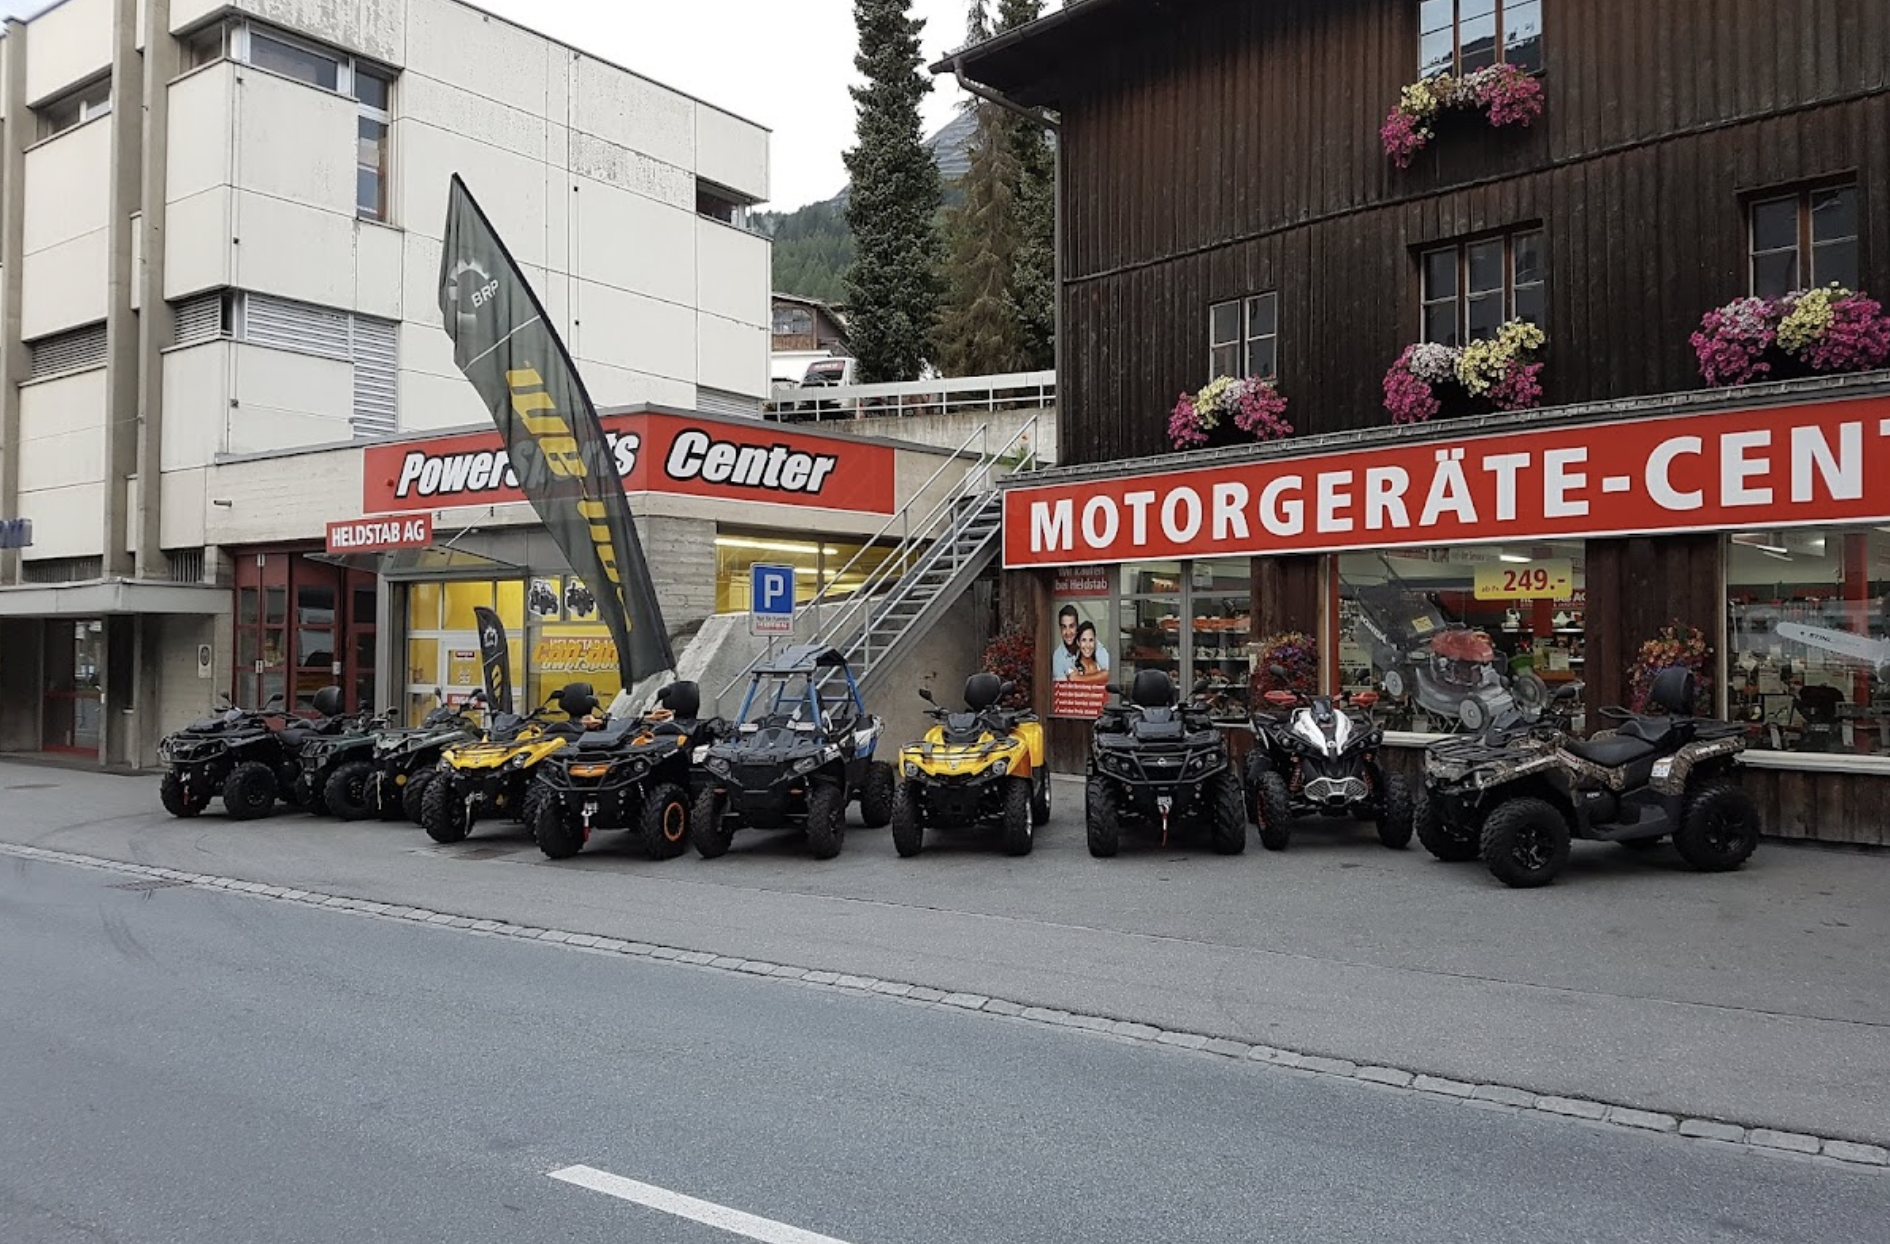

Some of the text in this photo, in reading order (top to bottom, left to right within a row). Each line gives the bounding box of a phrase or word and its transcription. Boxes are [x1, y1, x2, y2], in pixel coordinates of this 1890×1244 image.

[471, 280, 498, 308] BRP
[396, 431, 835, 497] PowerSts Center
[332, 519, 424, 547] HELDSTAB AG
[764, 574, 783, 608] P
[1070, 578, 1108, 590] Heldstab
